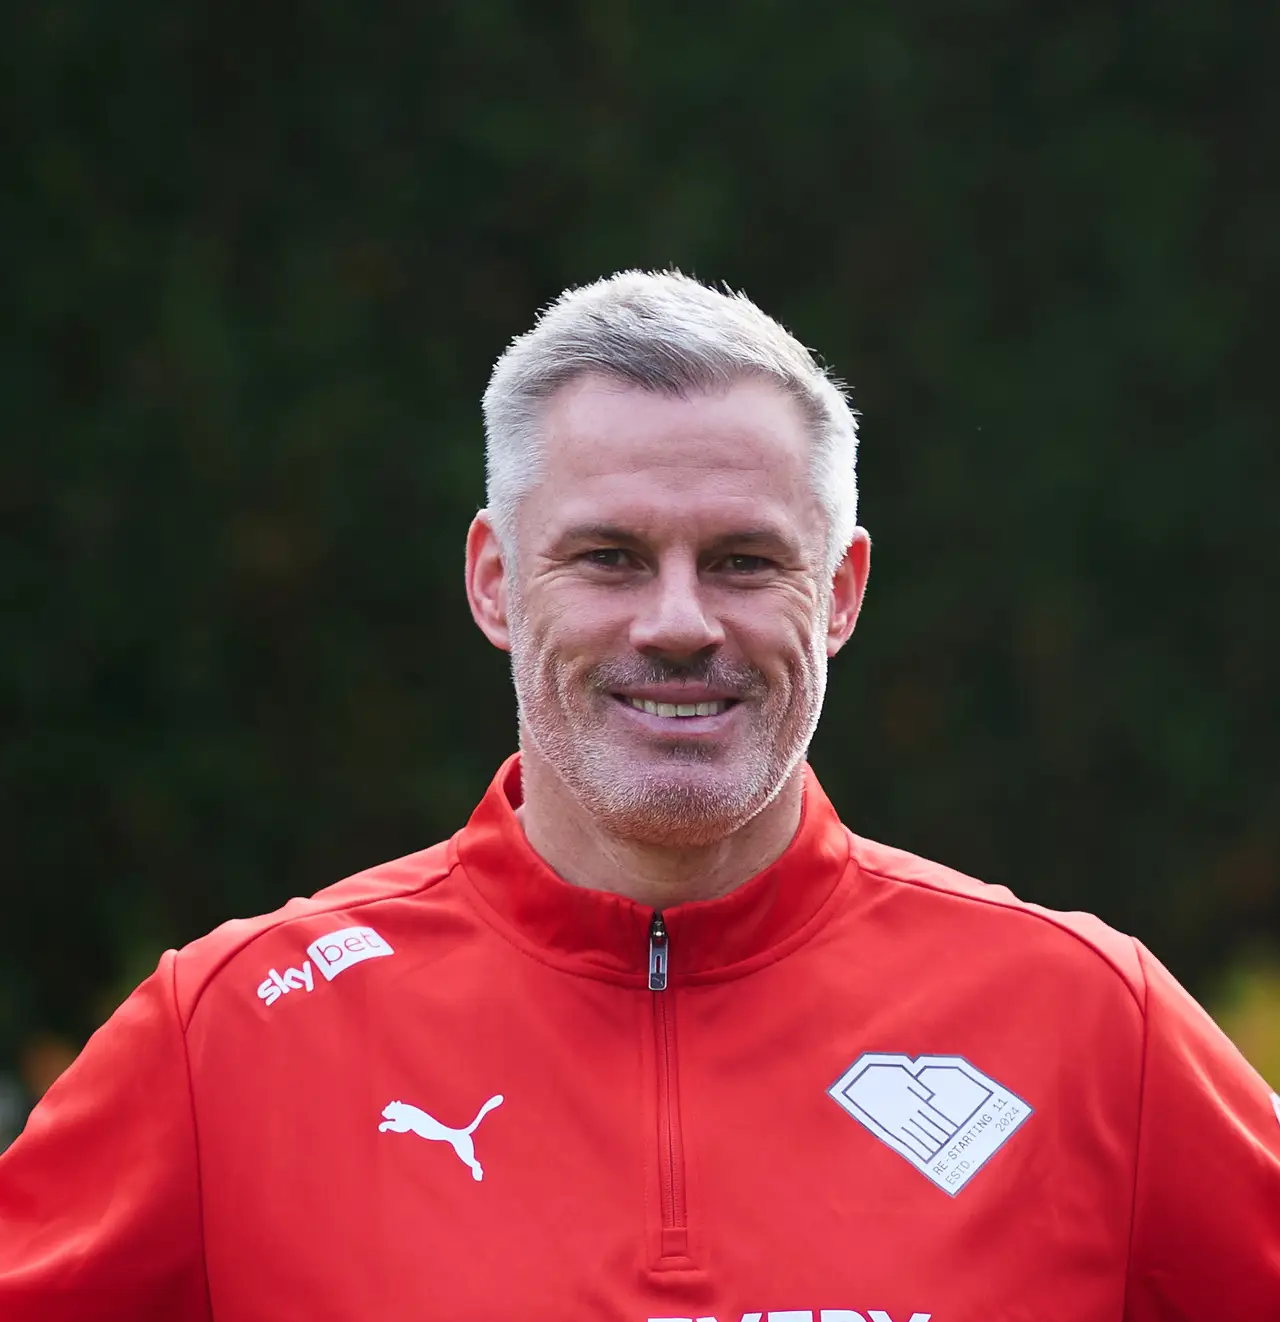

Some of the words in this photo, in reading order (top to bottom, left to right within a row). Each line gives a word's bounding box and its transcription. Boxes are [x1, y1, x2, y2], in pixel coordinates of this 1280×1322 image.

[257, 960, 314, 1006] sky
[316, 931, 381, 966] bet
[932, 1113, 993, 1176] RE-STARTING
[992, 1098, 1009, 1112] 11
[944, 1160, 975, 1185] ESTD.
[995, 1106, 1020, 1132] 2024
